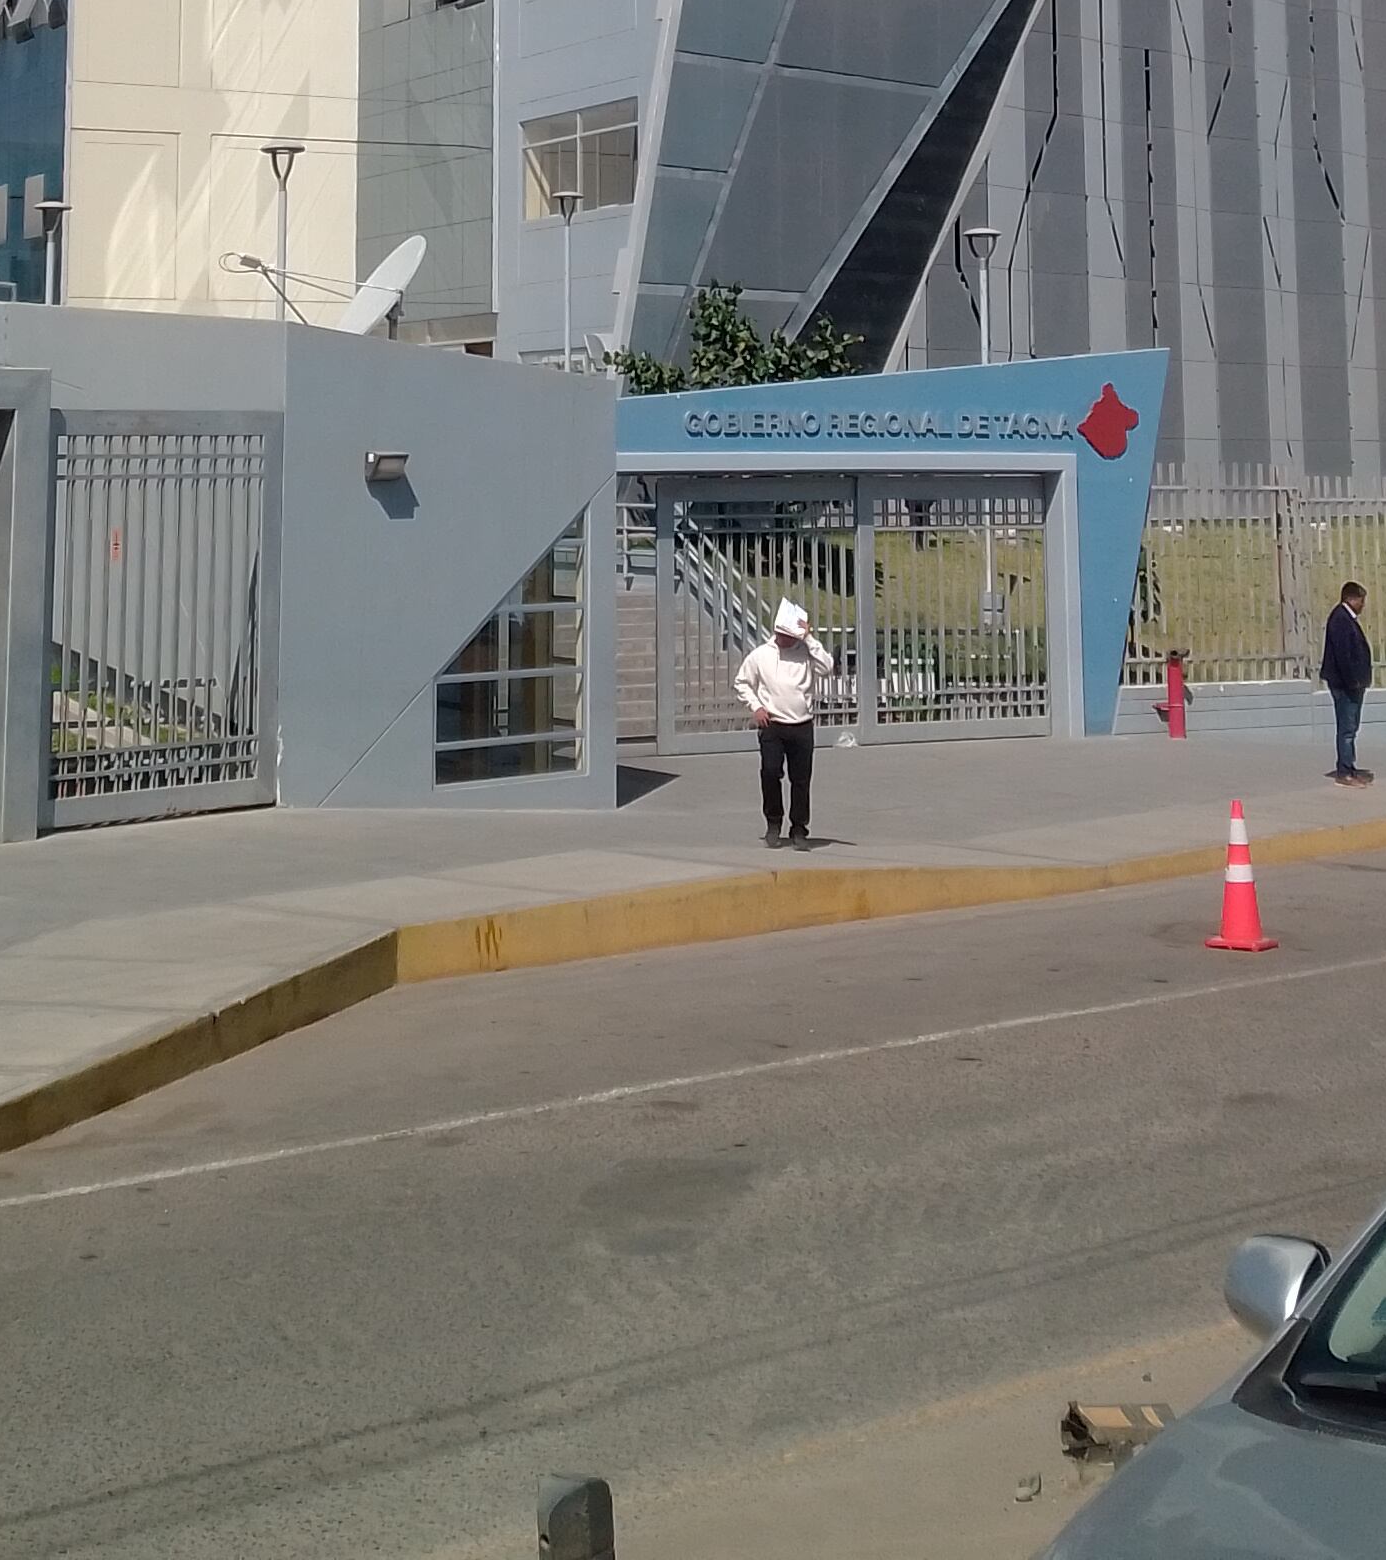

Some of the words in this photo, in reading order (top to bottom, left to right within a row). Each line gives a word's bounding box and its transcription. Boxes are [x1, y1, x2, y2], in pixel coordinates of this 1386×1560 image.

[685, 410, 821, 438] GOBIERNO
[826, 410, 953, 438] REGIONAL
[957, 412, 990, 438] DE
[993, 412, 1075, 440] TACNA
